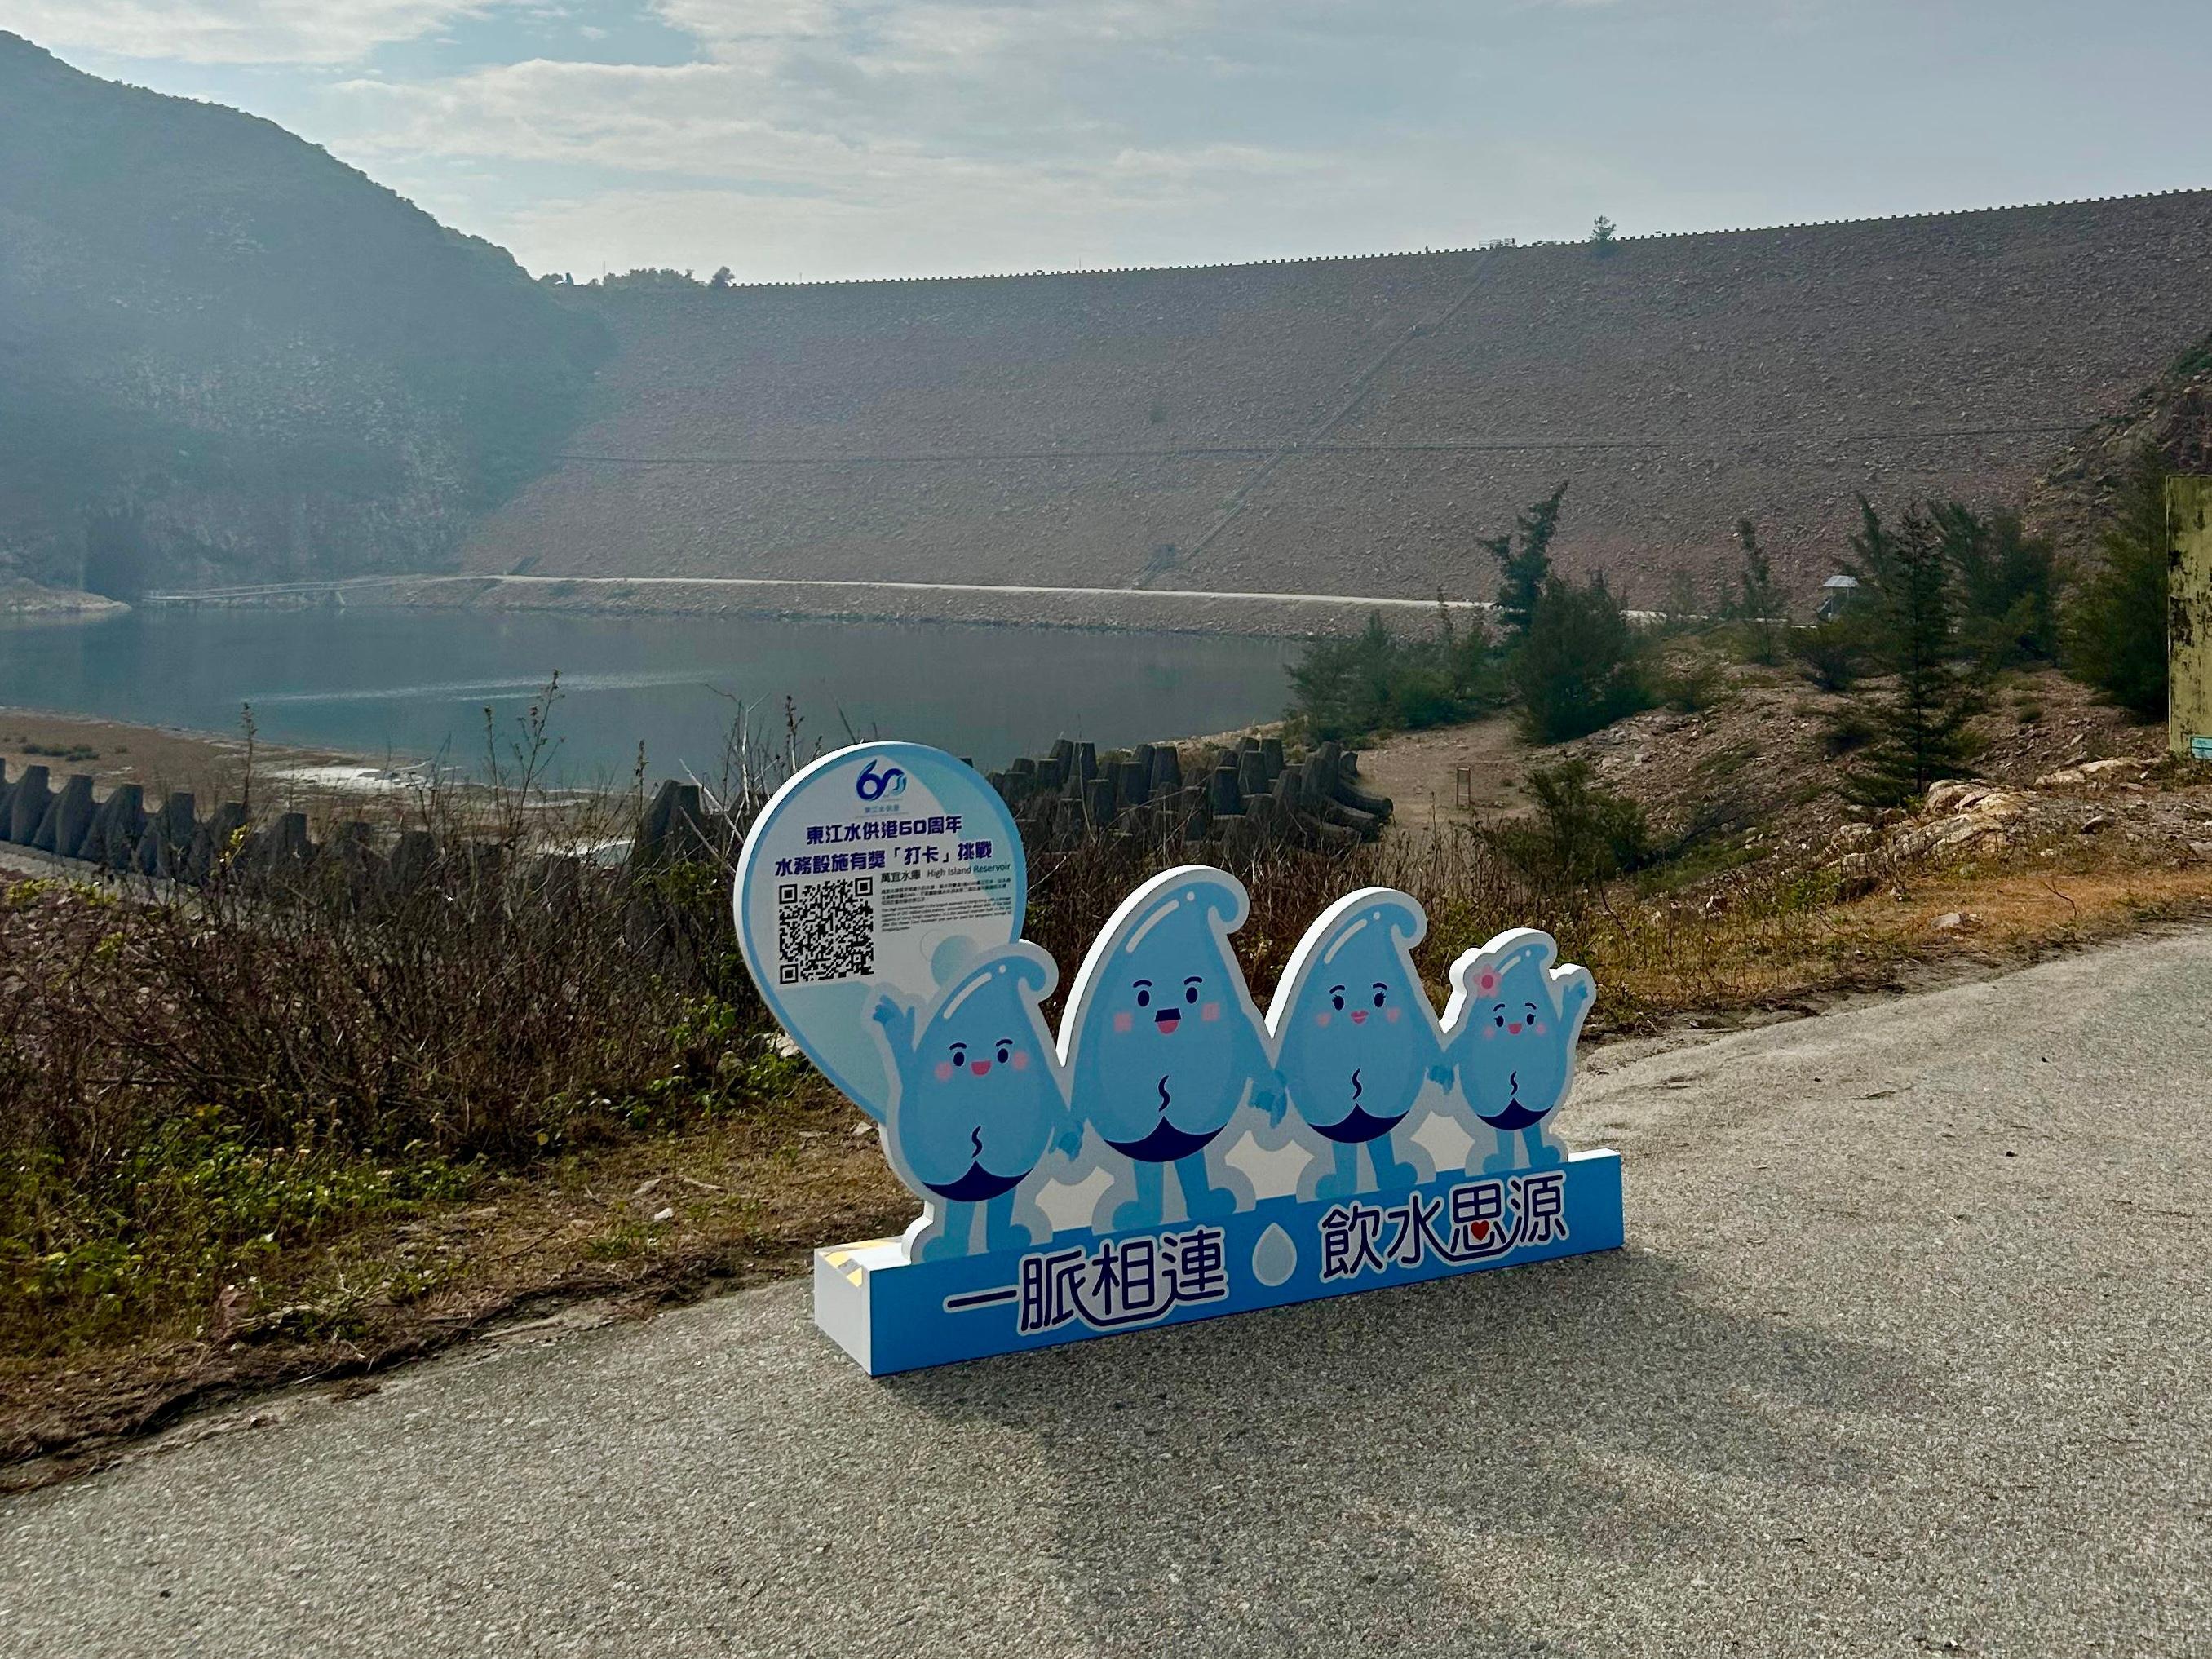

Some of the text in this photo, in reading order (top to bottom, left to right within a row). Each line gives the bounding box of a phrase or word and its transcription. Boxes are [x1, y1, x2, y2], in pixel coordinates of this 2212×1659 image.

[807, 816, 962, 844] 東江水供港60周年
[927, 862, 1011, 878] High Island Reservoir
[1321, 1173, 1568, 1278] 飲水思源
[945, 1228, 1226, 1333] 一脈相連
